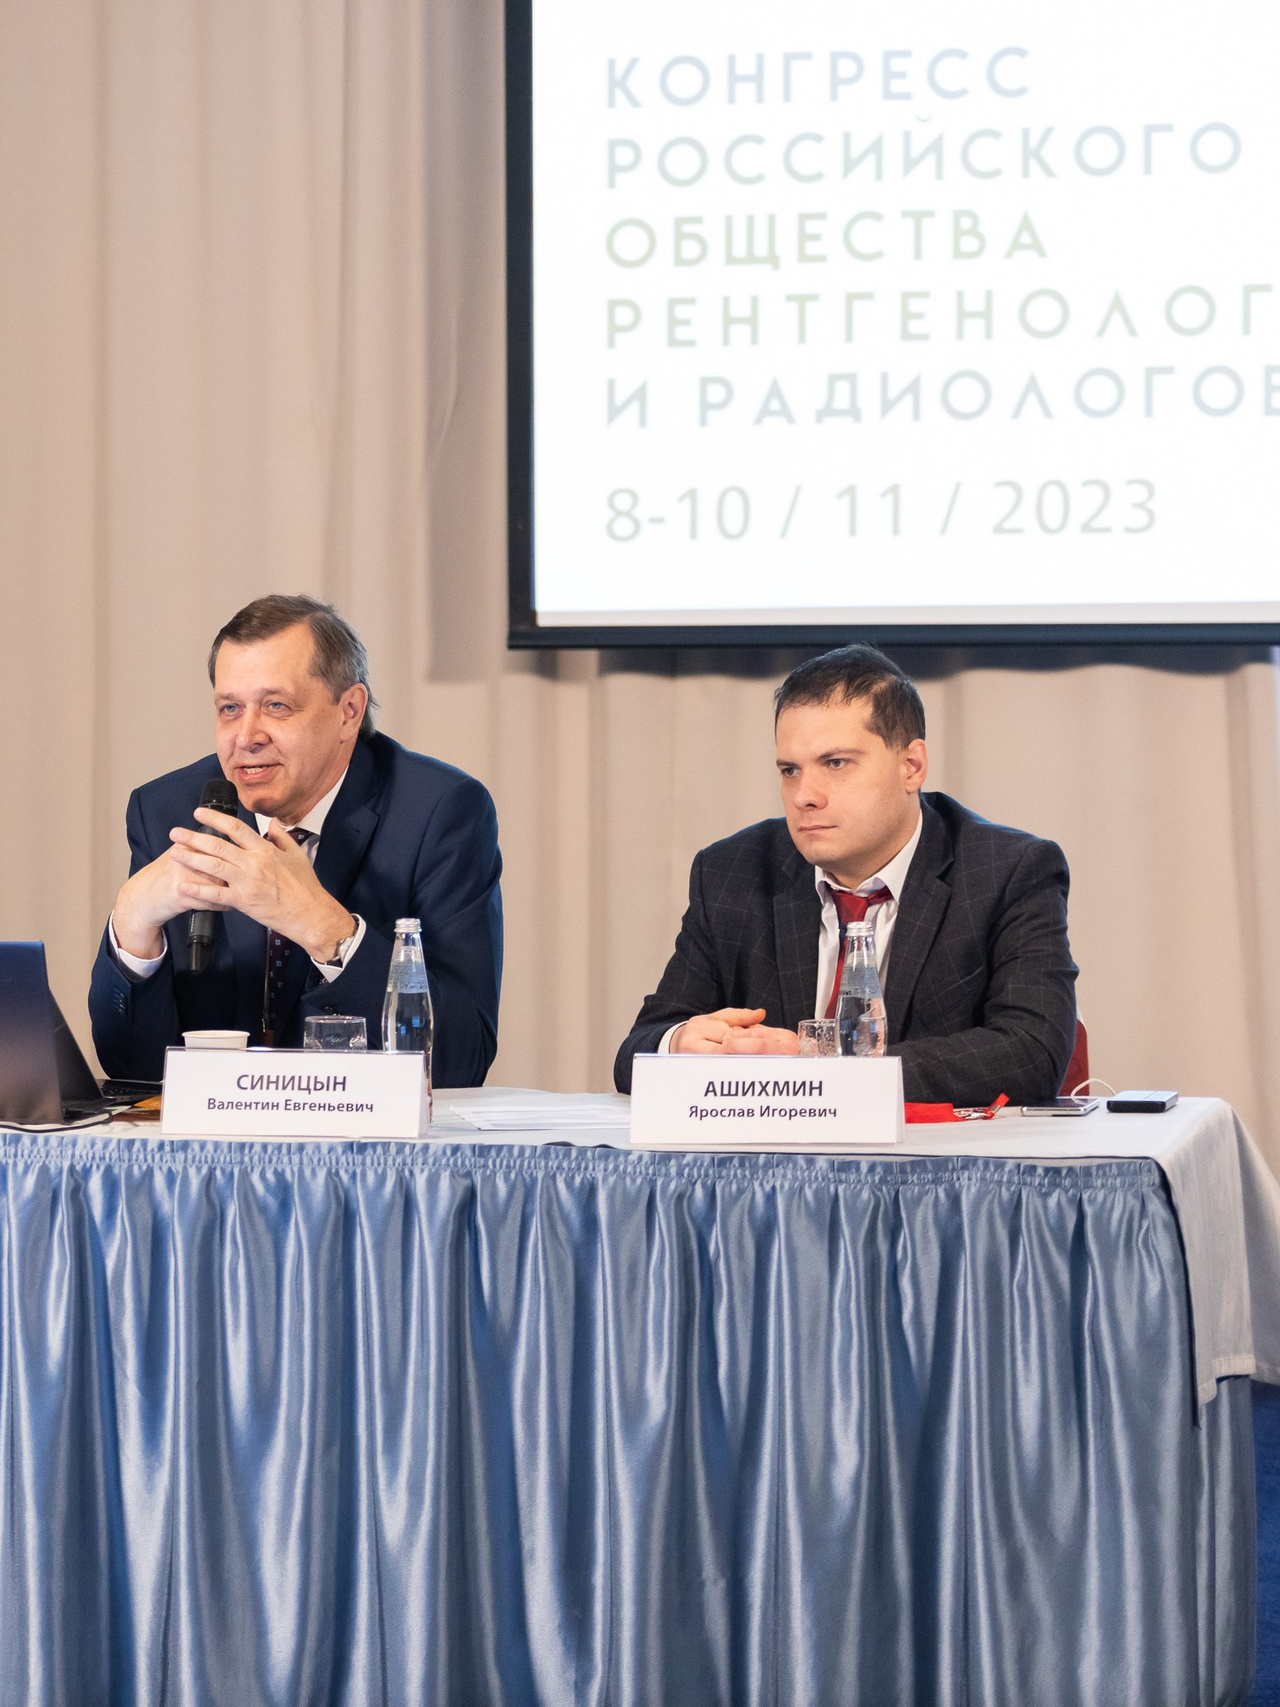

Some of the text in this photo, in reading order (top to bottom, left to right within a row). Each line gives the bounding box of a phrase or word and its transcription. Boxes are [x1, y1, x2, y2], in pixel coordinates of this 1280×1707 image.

[606, 46, 1030, 109] КОНГРЕСС
[606, 115, 1242, 190] РОССИЙСКОГО
[605, 209, 1048, 271] ОБЩЕСТВА
[606, 378, 648, 429] И
[605, 478, 1157, 542] 8-10 / 11 / 2023
[207, 1097, 375, 1114] Валентин Евгеньевич
[236, 1074, 347, 1095] СИНИЦЫН
[703, 1080, 824, 1098] АШИХМИН
[688, 1105, 837, 1121] Ярослав Игоревич
